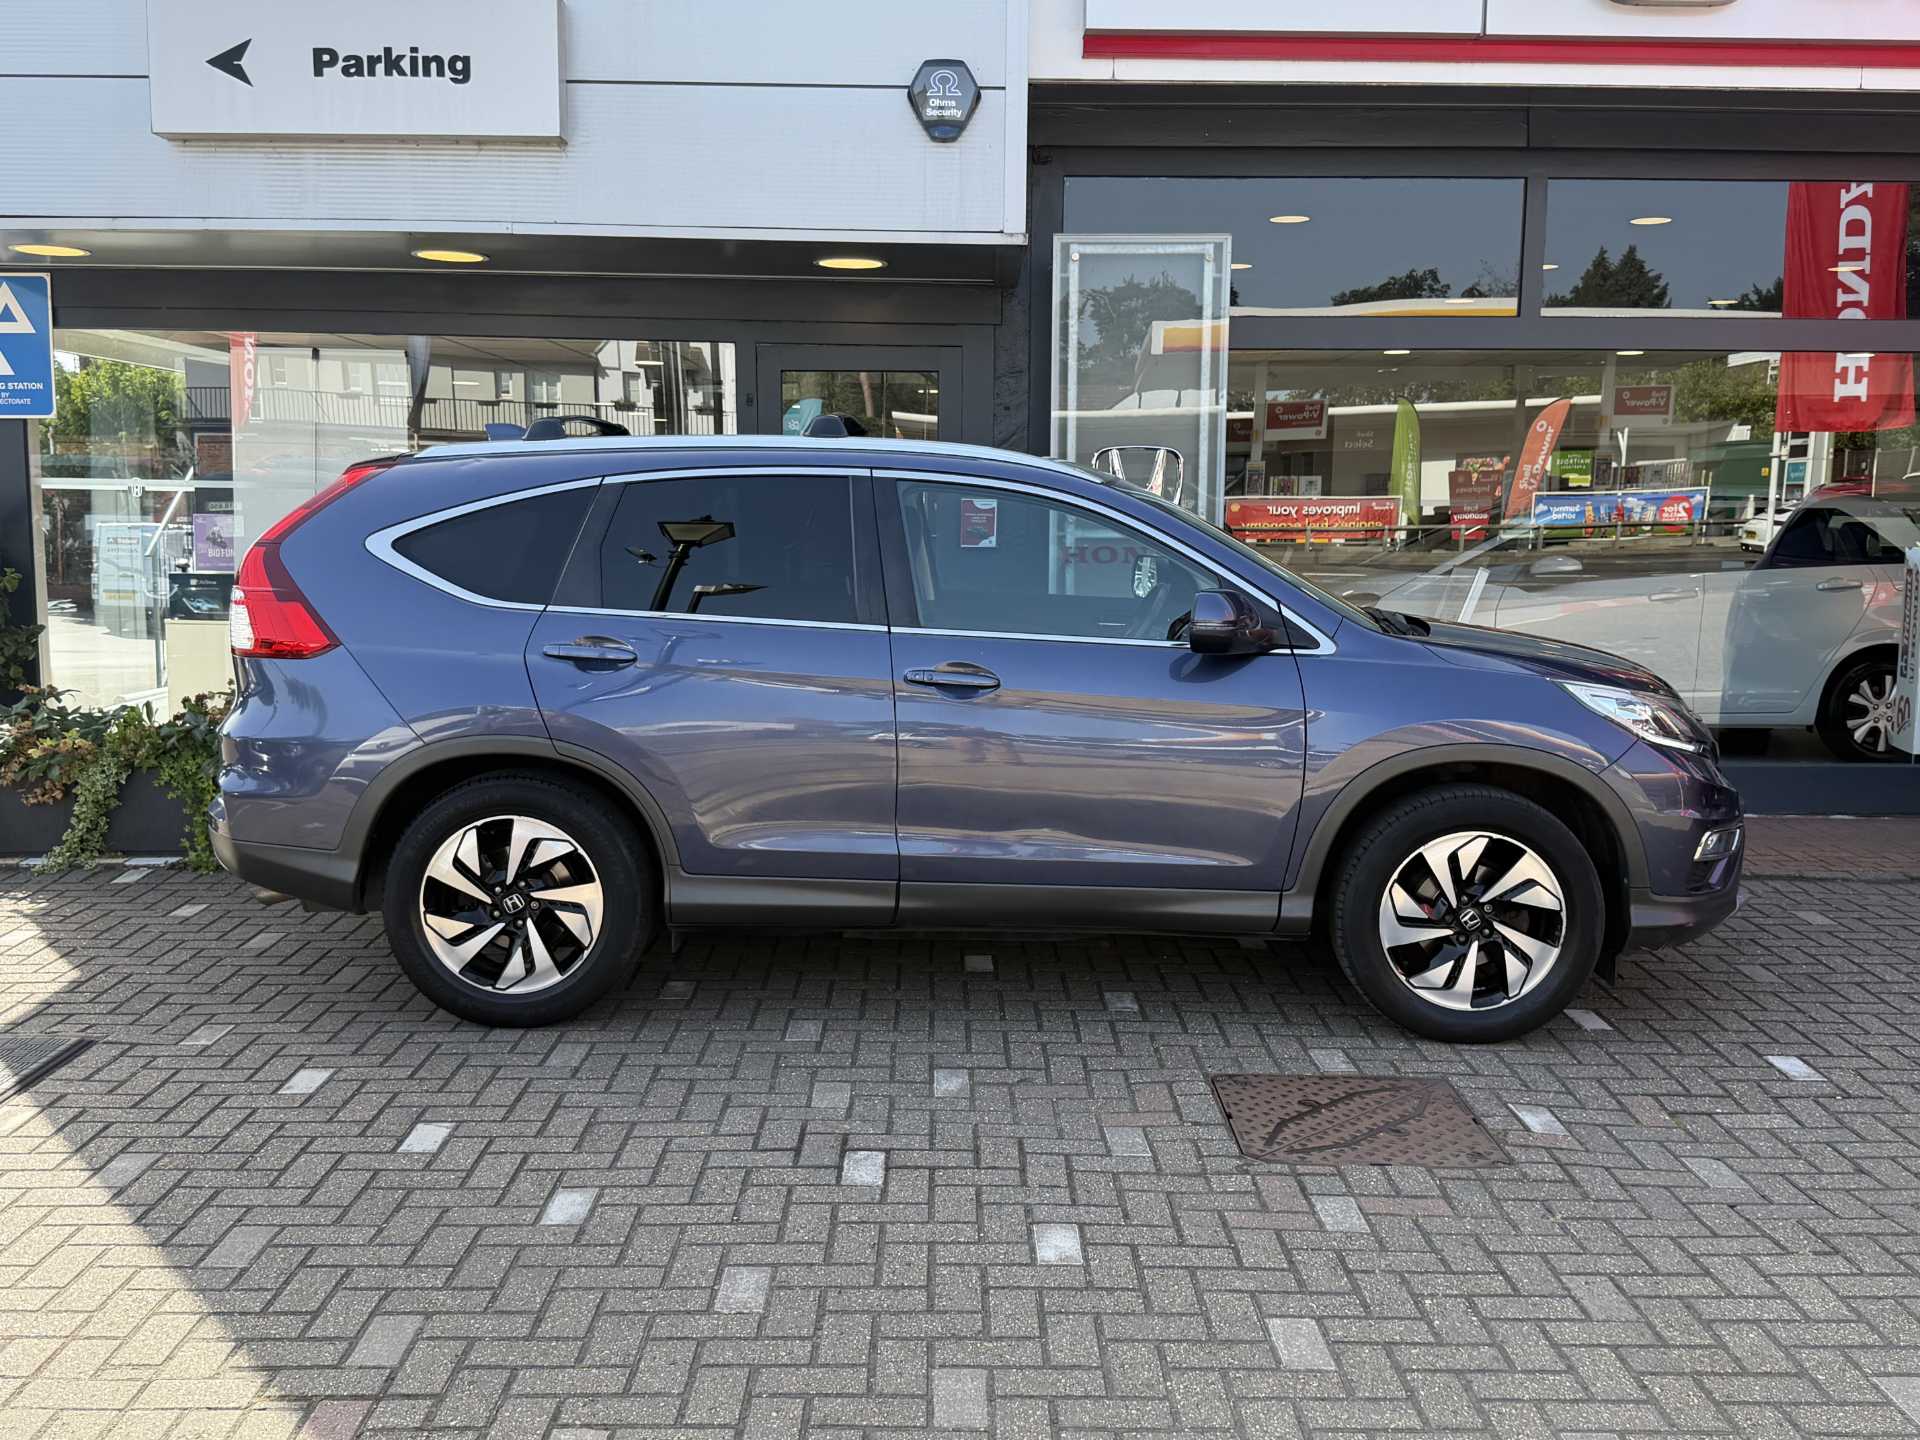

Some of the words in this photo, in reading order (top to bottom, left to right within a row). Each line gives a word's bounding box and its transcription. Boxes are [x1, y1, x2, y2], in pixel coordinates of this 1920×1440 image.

[312, 46, 471, 85] Parking
[929, 98, 956, 107] Ohms
[926, 107, 963, 118] Security
[7, 382, 44, 390] STATION
